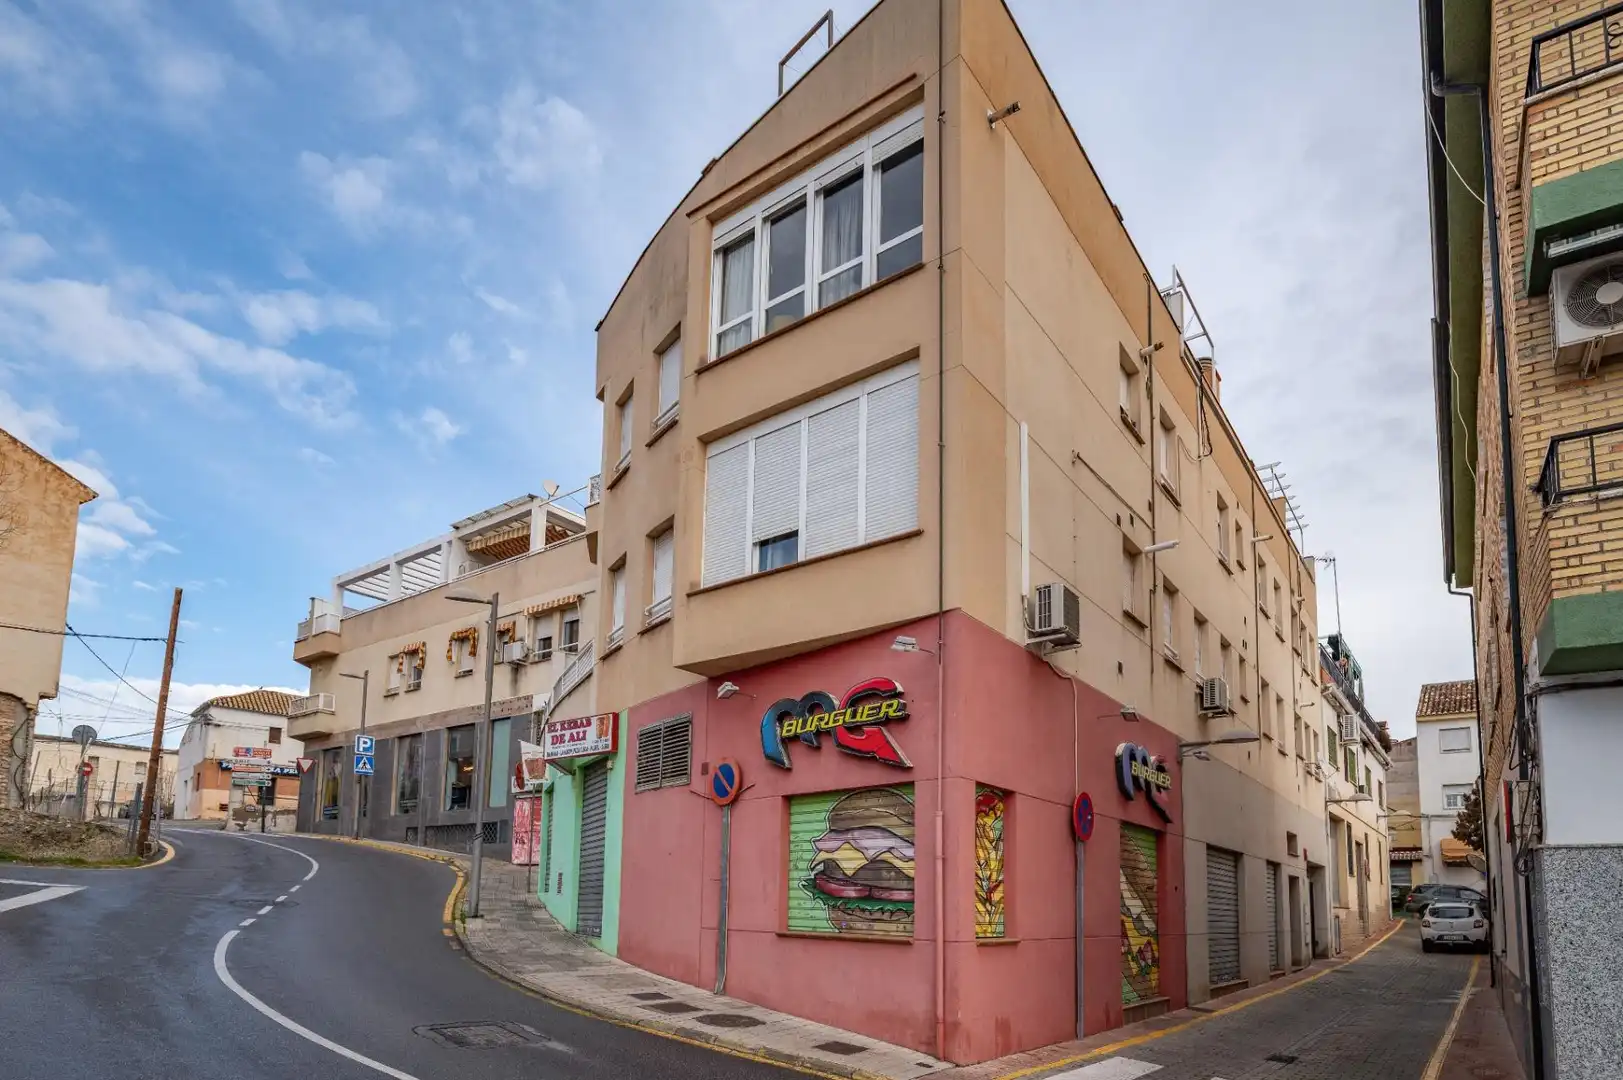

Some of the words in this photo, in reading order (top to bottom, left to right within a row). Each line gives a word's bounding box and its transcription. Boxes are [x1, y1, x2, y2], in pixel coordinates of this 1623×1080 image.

[547, 720, 559, 734] EL
[560, 716, 592, 731] KEBAB
[781, 699, 906, 739] BURGUER
[359, 737, 371, 752] P
[550, 733, 566, 746] DE
[567, 729, 588, 743] ALI
[1131, 760, 1172, 790] BURGUER
